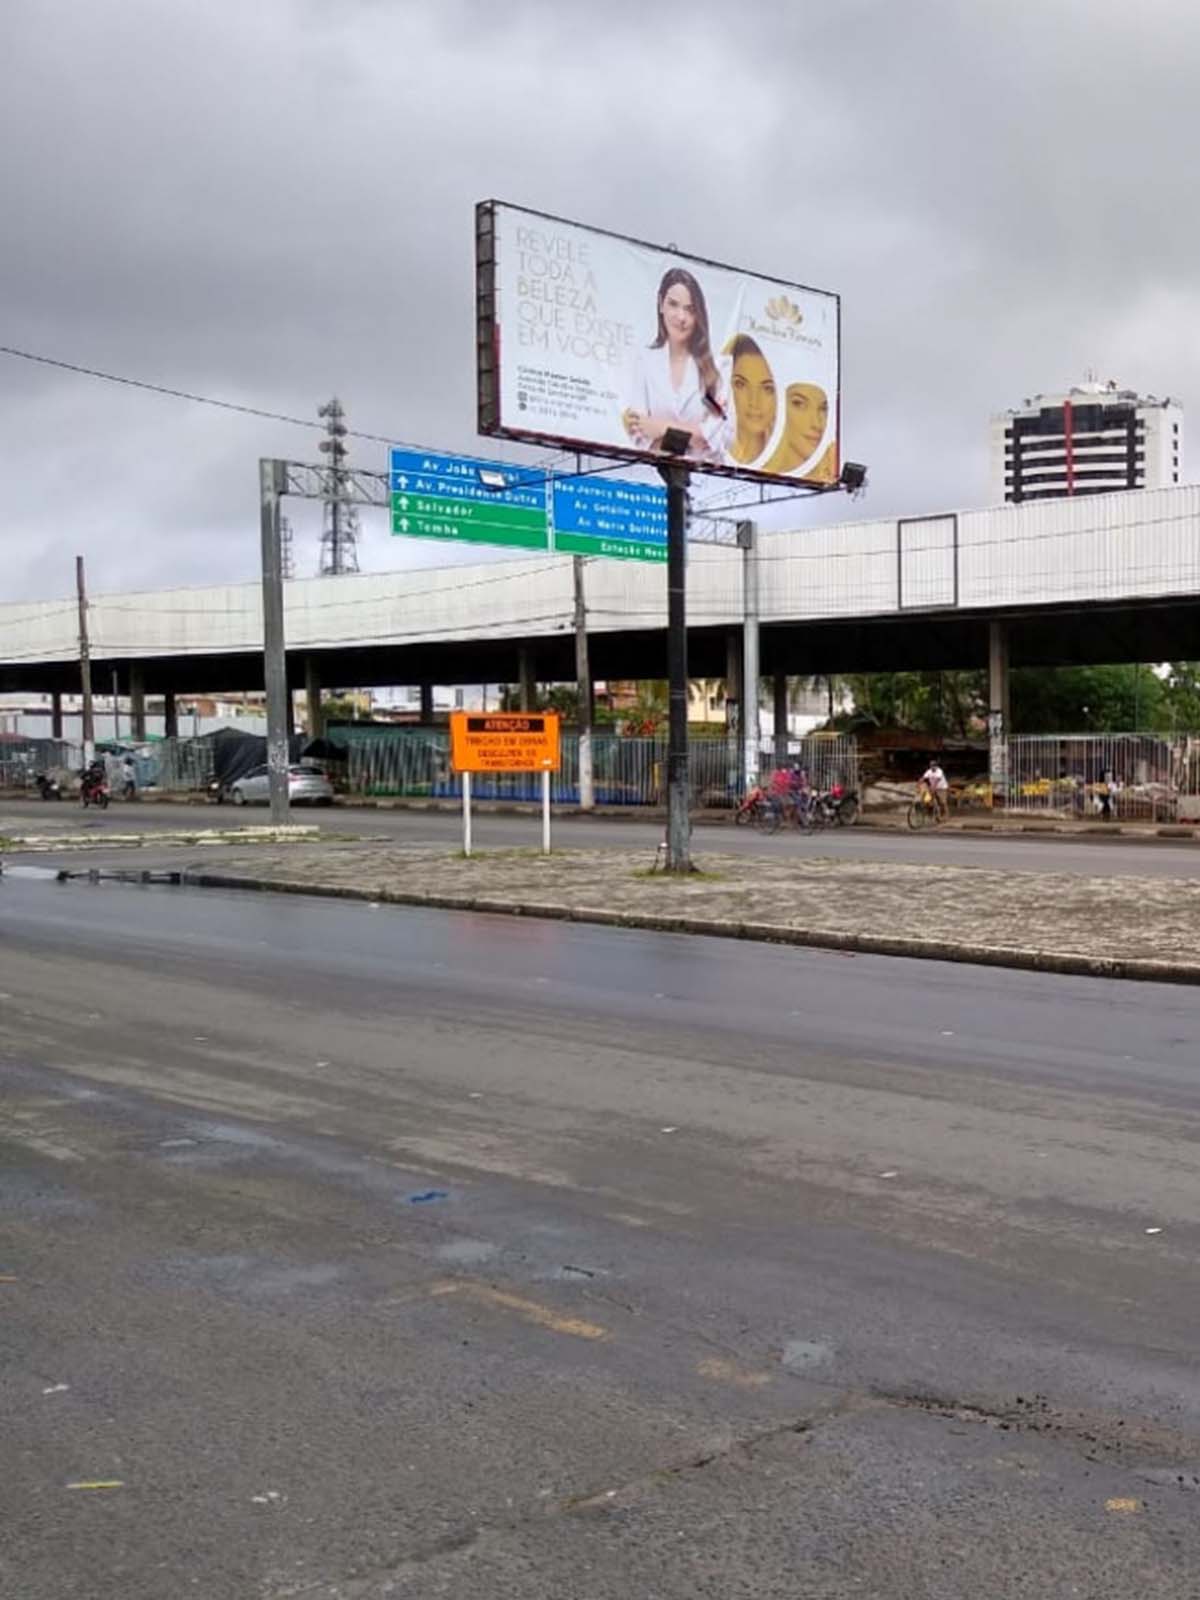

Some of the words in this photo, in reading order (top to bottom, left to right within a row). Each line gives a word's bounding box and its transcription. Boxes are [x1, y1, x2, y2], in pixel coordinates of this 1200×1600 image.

[516, 251, 577, 287] TODA
[517, 275, 597, 314] BELEZA
[518, 301, 568, 330] QUE
[517, 324, 549, 351] EM
[416, 499, 473, 517] Salvador
[416, 519, 459, 536] Tomba
